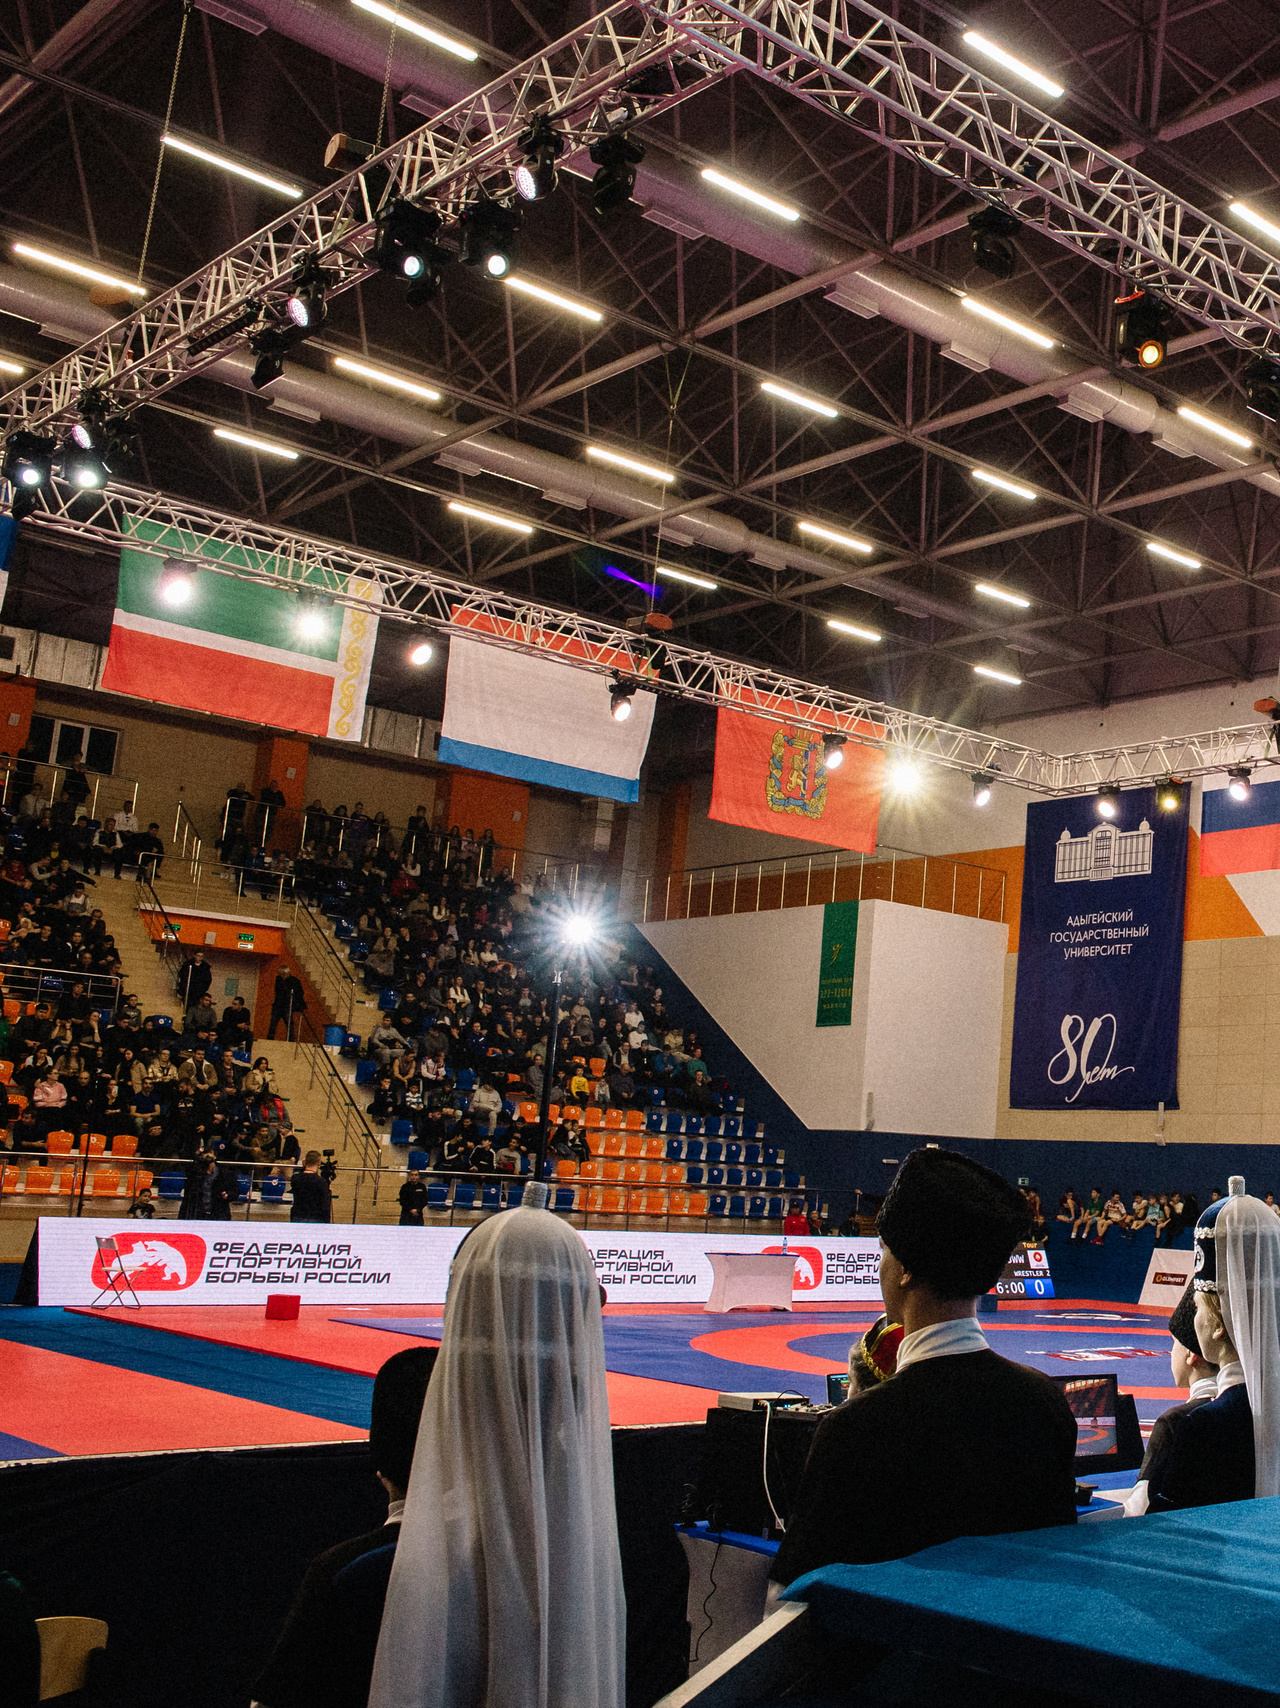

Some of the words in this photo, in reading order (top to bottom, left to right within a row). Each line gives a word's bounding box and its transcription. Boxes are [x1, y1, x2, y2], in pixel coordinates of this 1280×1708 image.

[1066, 908, 1134, 927] АДЫГЕЙСКИЙ
[1049, 923, 1149, 944] ГОСУДАРСТВЕННЫЙ
[1063, 943, 1133, 960] УНИВЕРСИТЕТ
[1048, 1013, 1117, 1085] 80
[1065, 1063, 1135, 1103] лет
[212, 1242, 352, 1257] ФЕДЕРАЦИЯ
[208, 1255, 362, 1270] СПОРТИВНОЙ
[205, 1271, 300, 1284] БОРЬБЫ
[304, 1272, 391, 1284] РОССИИ
[629, 1274, 697, 1284] РОССИИ
[996, 1281, 1025, 1294] 6:00
[1034, 1279, 1045, 1295] 0
